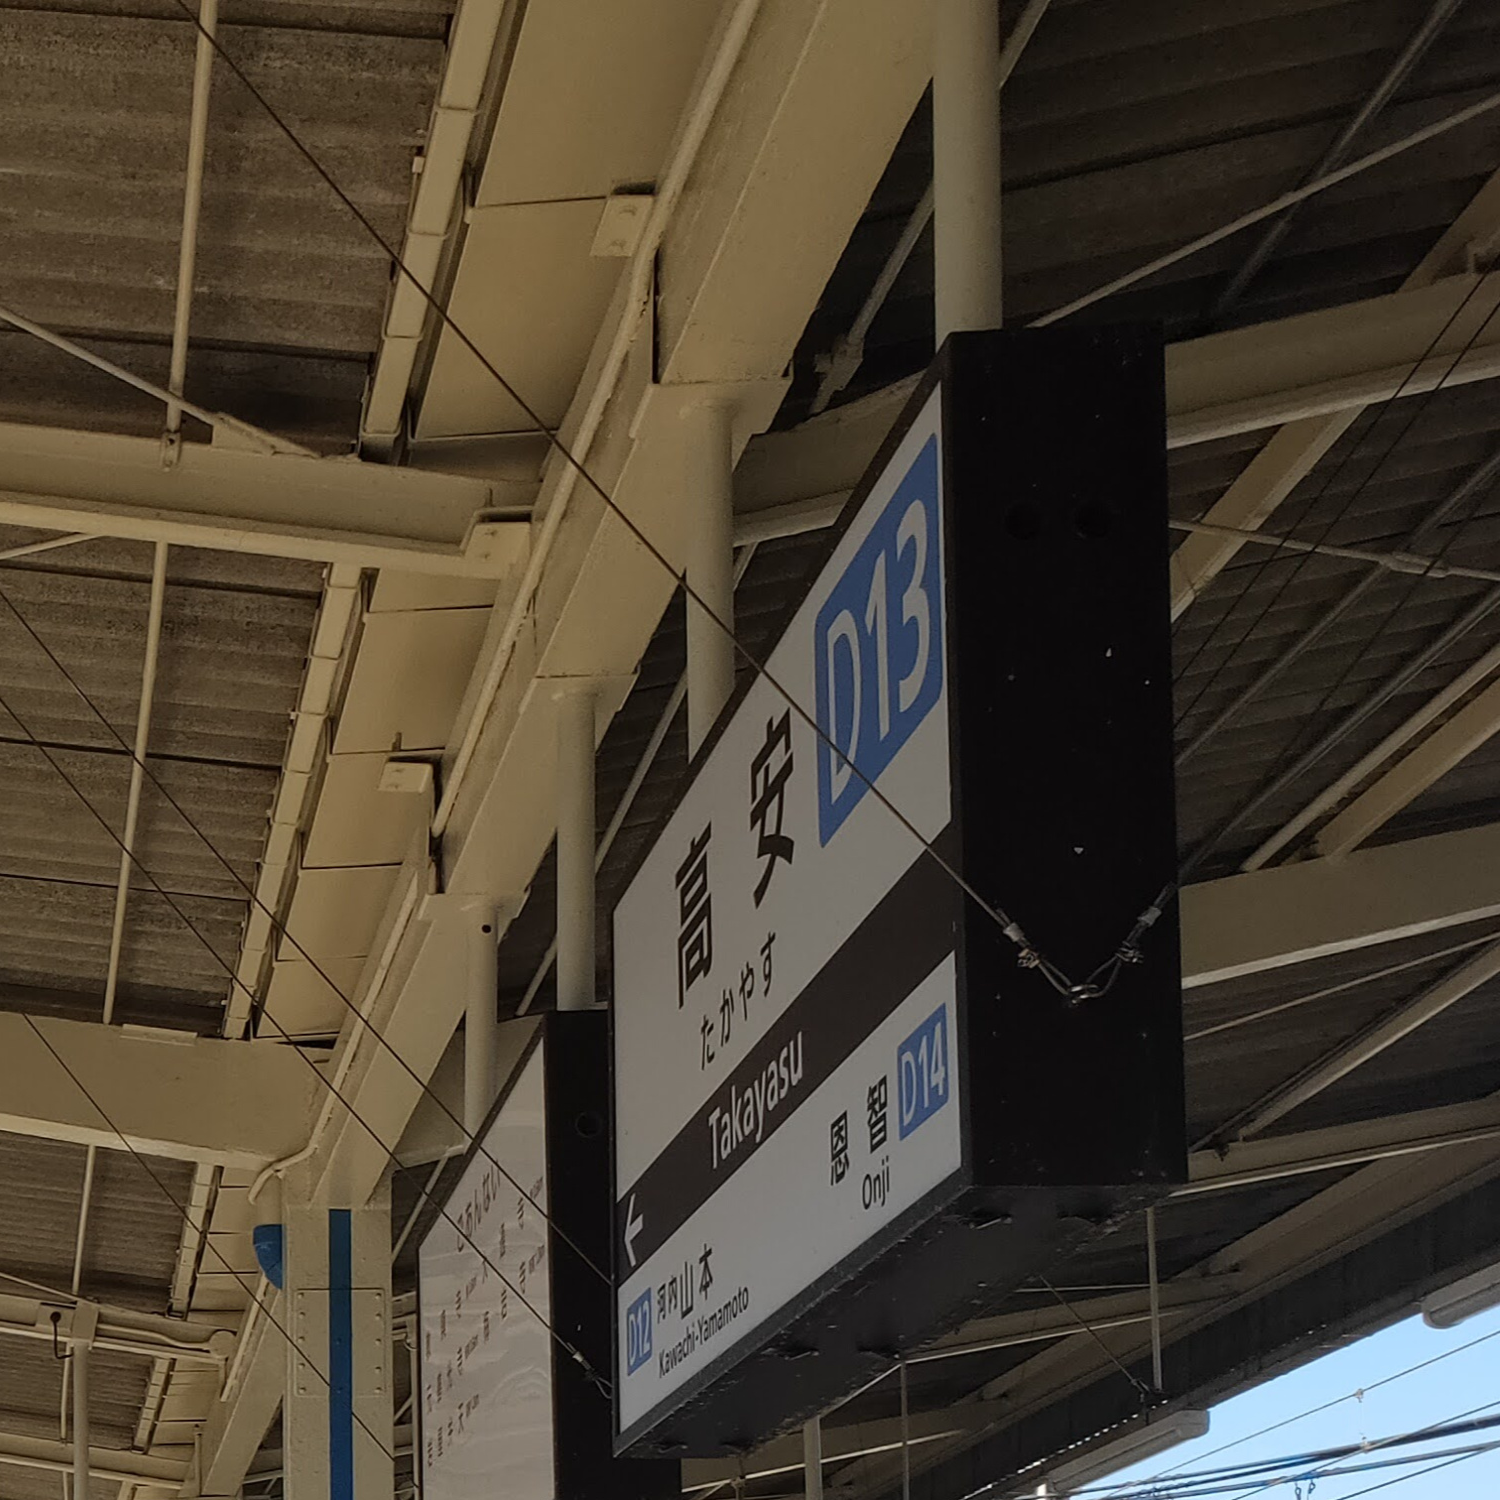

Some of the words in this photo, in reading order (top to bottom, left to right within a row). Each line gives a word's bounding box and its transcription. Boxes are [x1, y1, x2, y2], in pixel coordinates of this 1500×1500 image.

[827, 498, 930, 805] D13
[675, 708, 794, 1009] 高安
[700, 931, 776, 1070] たかやす
[708, 1031, 802, 1169] Takayasu
[901, 1022, 946, 1128] D14
[830, 1075, 888, 1186] 恩智
[862, 1170, 890, 1210] Onji
[628, 1303, 652, 1370] D12
[657, 1243, 713, 1324] 河内山本
[659, 1285, 749, 1378] Kawachi-Yamamoto
